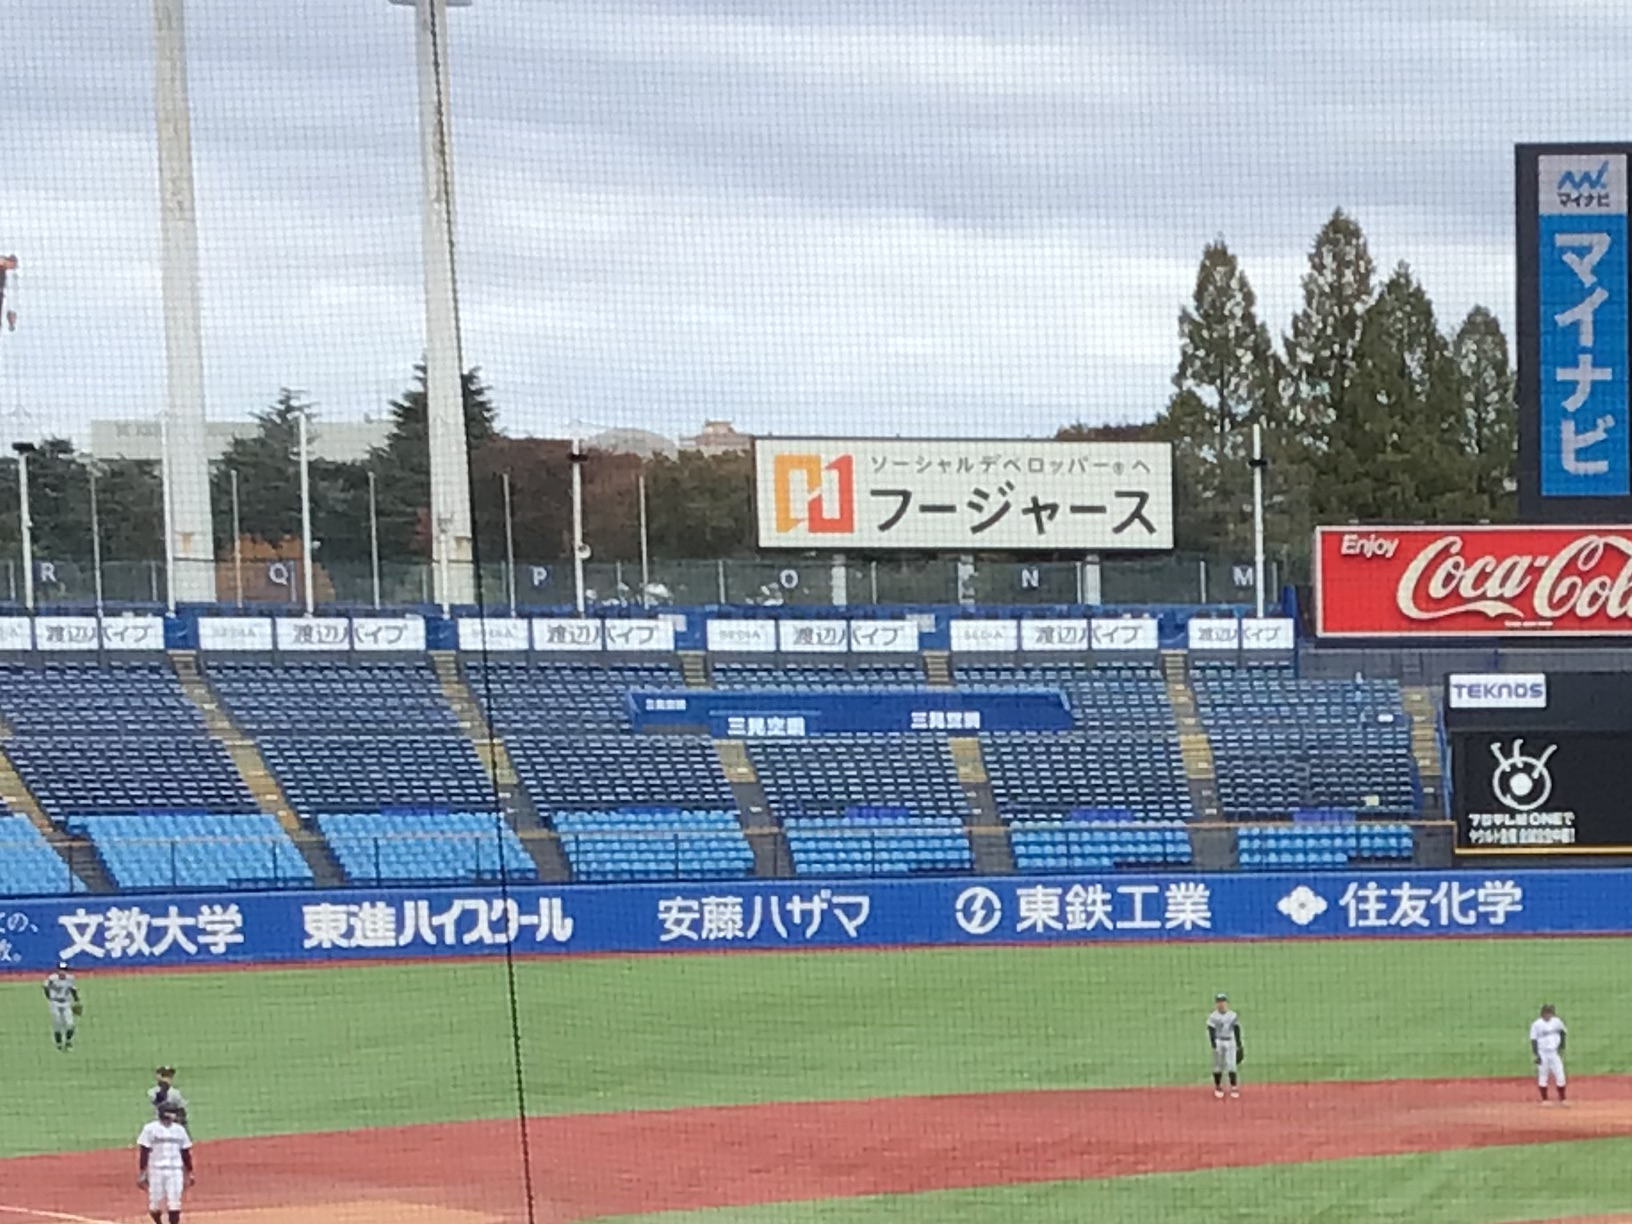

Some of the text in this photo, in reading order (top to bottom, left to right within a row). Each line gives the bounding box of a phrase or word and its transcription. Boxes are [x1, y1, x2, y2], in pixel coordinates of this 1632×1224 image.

[1556, 192, 1610, 207] マイナビ
[1552, 231, 1616, 476] マイナビ
[869, 480, 1157, 537] フージャース
[1340, 534, 1399, 558] Enjoy
[1021, 569, 1040, 589] N
[1452, 682, 1544, 699] TEKNOS
[302, 894, 574, 949] 東進ハイスクール
[657, 888, 871, 942] 安藤ハザマ
[1015, 882, 1212, 932] 東鉄工業
[1339, 880, 1524, 928] 住友化学
[58, 903, 245, 959] 文教大学
